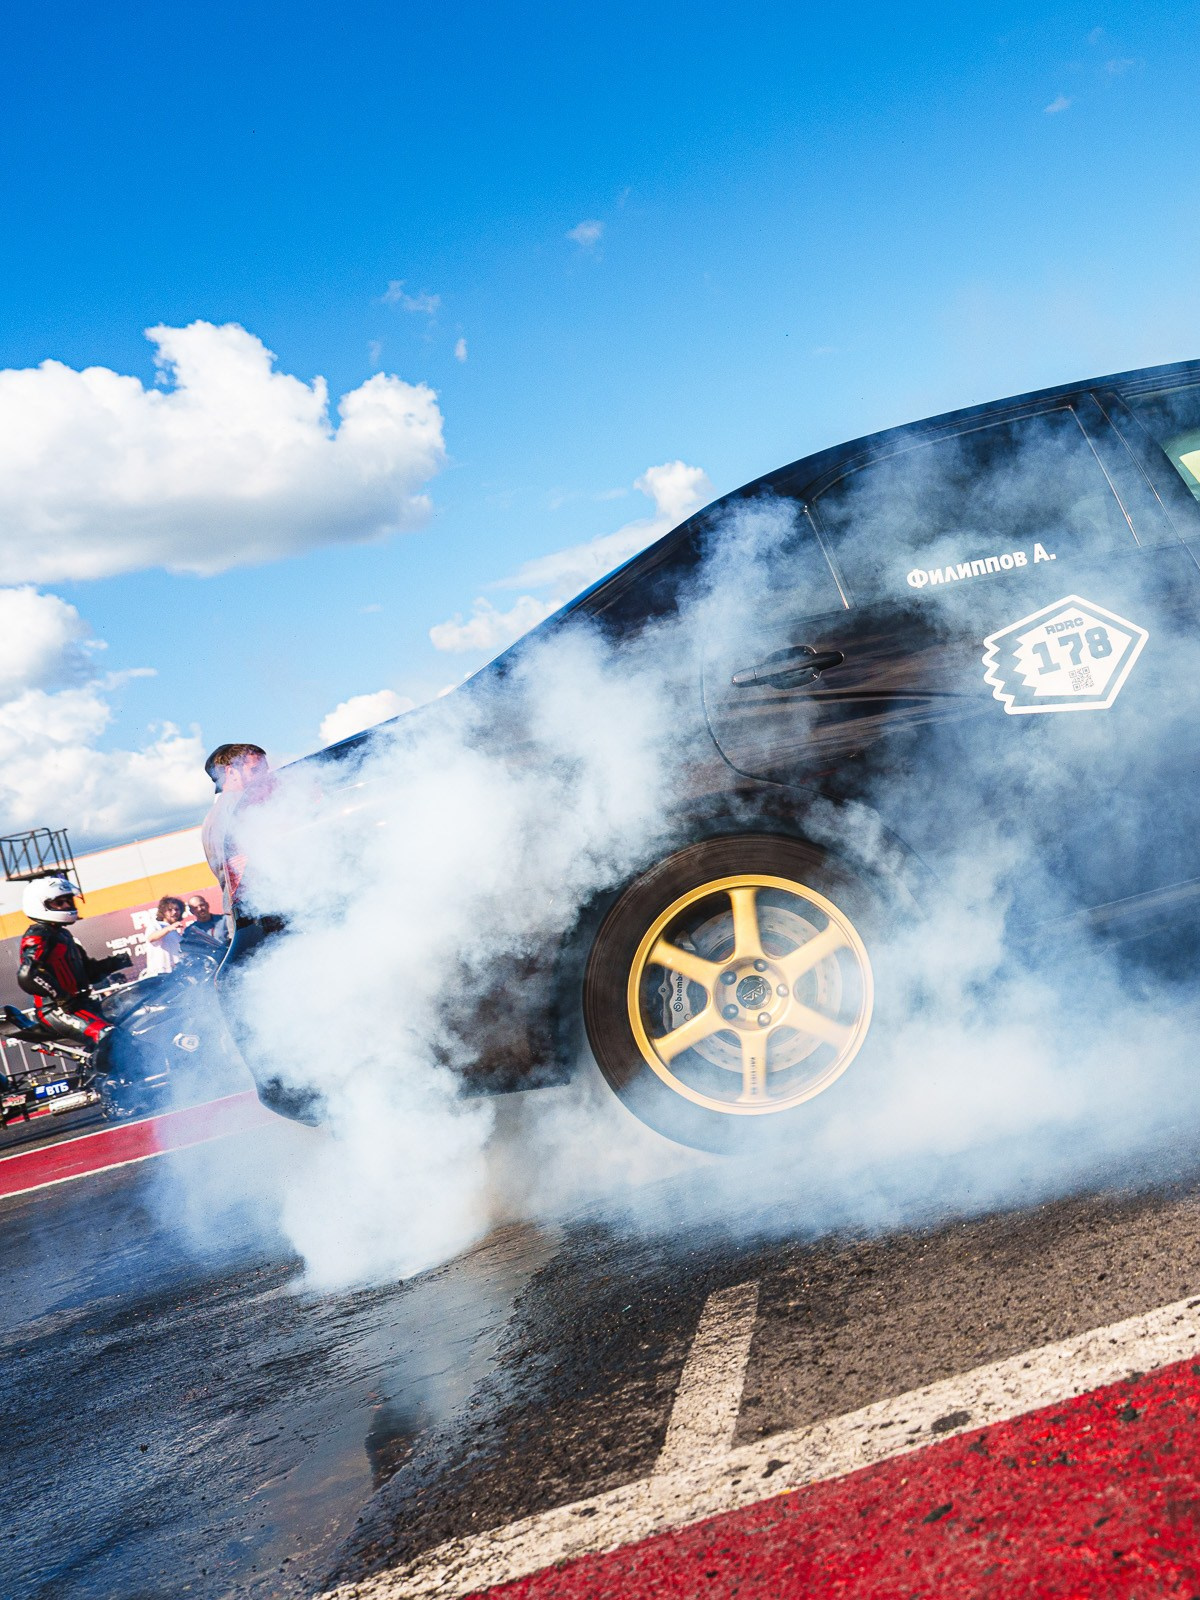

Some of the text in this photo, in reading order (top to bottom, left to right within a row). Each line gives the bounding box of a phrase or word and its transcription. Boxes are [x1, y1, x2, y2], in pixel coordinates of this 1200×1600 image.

[1033, 542, 1057, 563] А.
[1044, 617, 1084, 634] RDRC
[1031, 626, 1113, 675] 178
[45, 1082, 69, 1096] ВТБ
